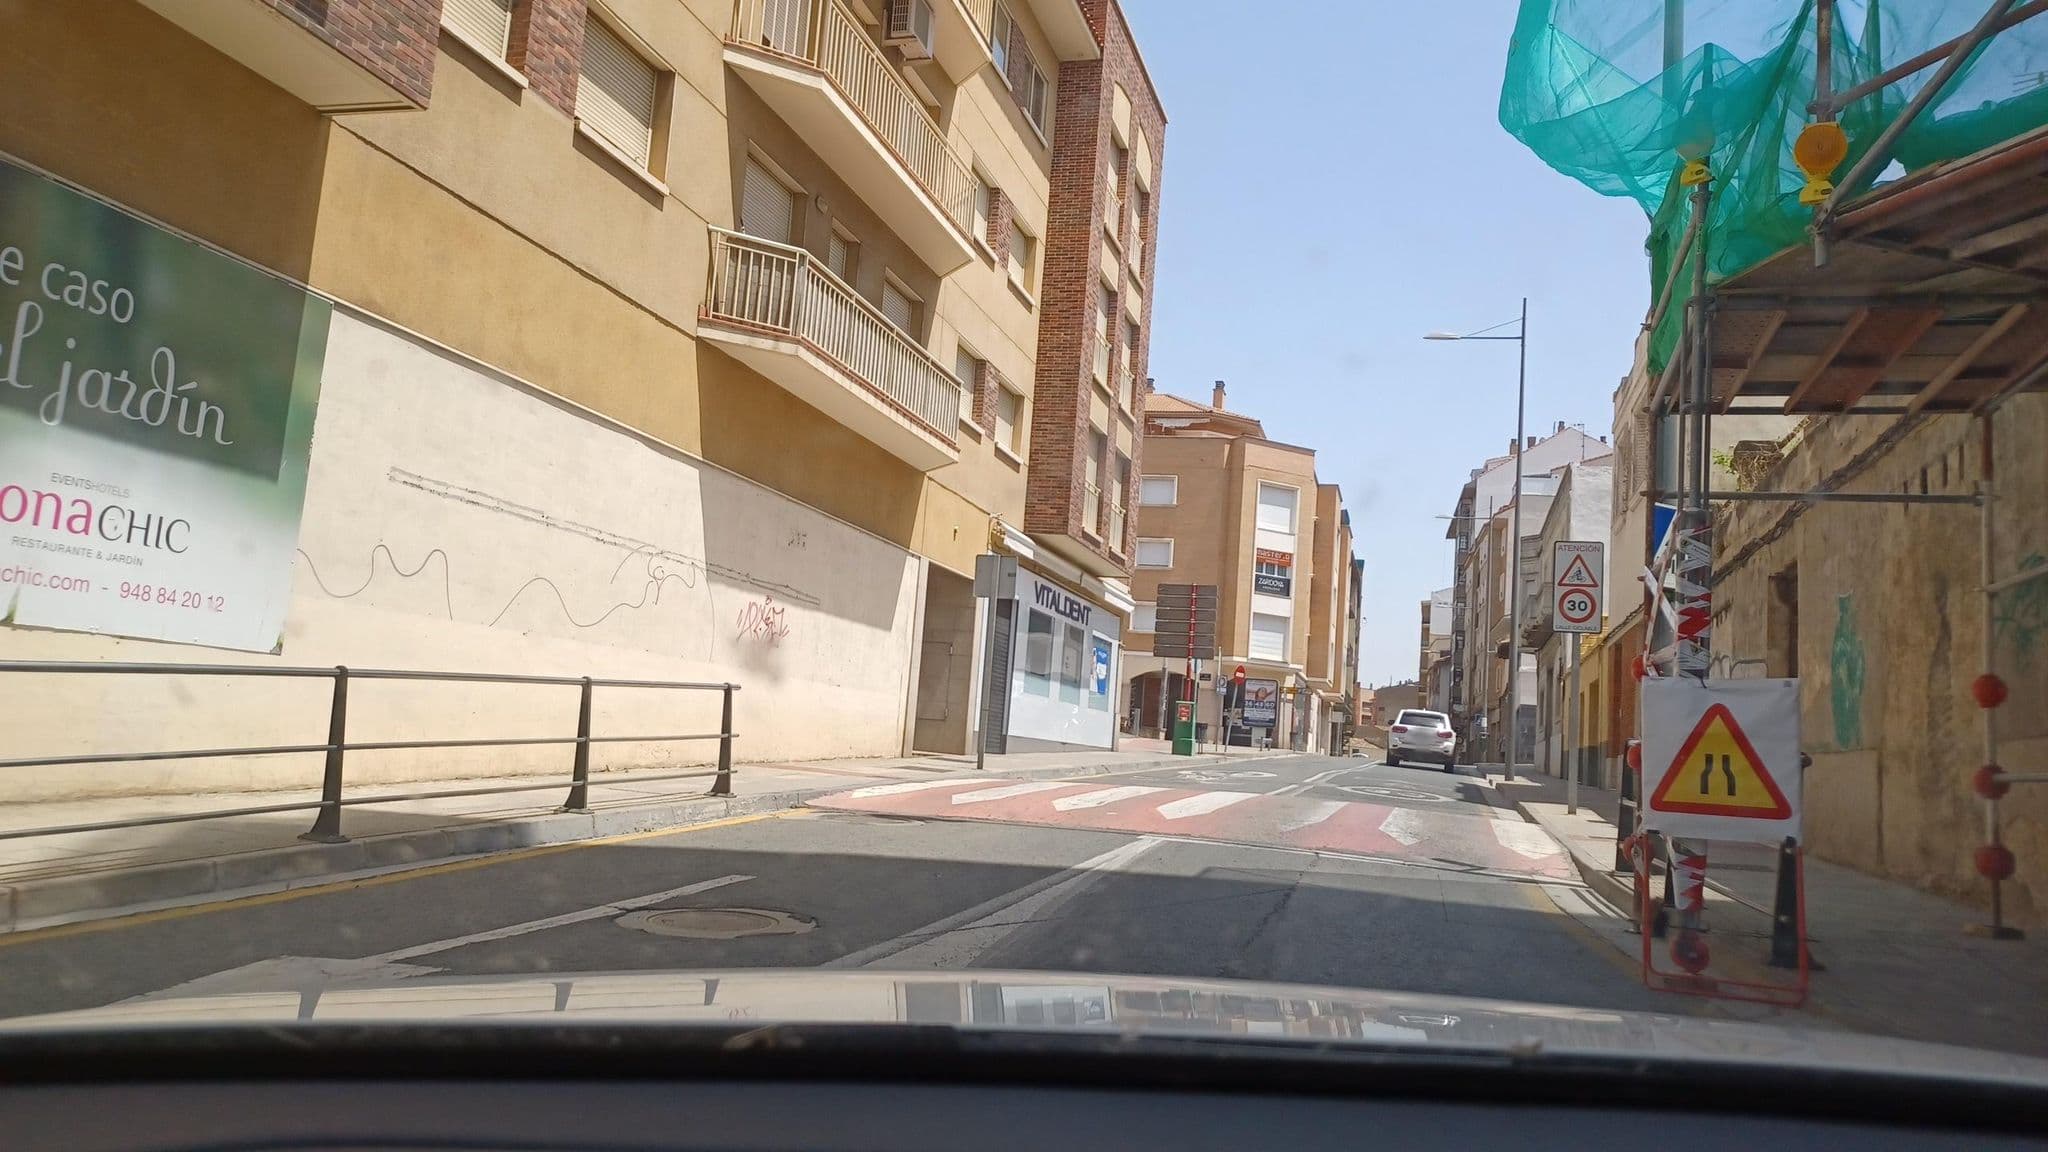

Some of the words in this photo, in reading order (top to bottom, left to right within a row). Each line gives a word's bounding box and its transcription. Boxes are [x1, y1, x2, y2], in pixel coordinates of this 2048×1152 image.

[41, 262, 135, 323] caso
[0, 300, 44, 388] l
[39, 337, 234, 445] jardín
[11, 535, 93, 559] RESTAURANTE
[96, 549, 103, 560] &
[106, 551, 144, 567] JARDÍN
[1557, 544, 1601, 553] ATENCIÓN
[0, 565, 91, 593] chic.com
[119, 580, 152, 602] 948
[156, 586, 177, 606] 84
[181, 590, 202, 609] 20
[207, 594, 226, 613] 12
[1034, 580, 1093, 626] VITALDENT
[1567, 600, 1588, 611] 30
